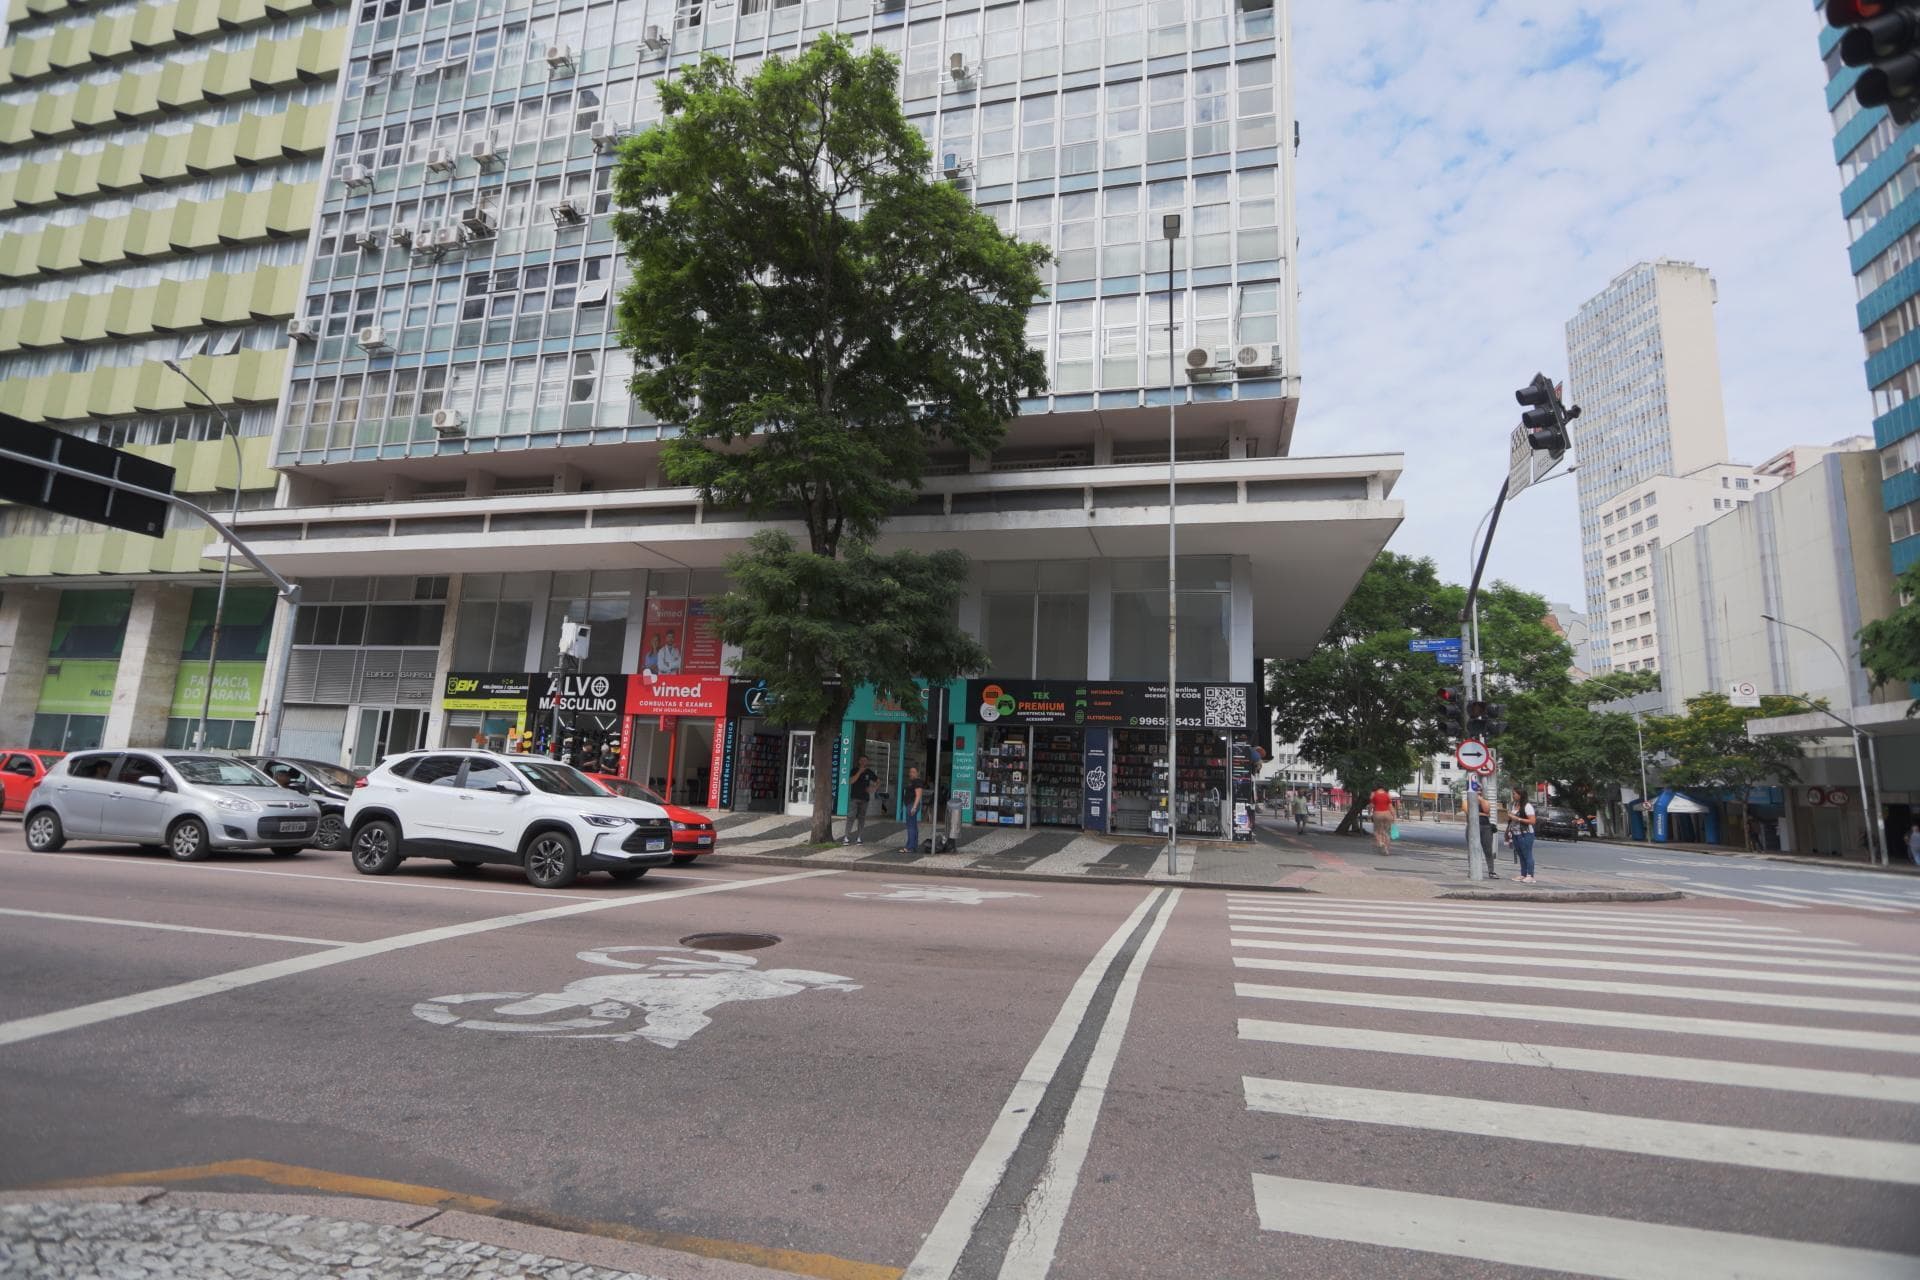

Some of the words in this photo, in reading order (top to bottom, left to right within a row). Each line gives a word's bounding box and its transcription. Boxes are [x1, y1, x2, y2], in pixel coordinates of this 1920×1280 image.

[184, 687, 200, 699] DO
[547, 676, 609, 697] ALVO
[652, 682, 701, 698] vimed
[539, 697, 617, 711] MASCULINO
[1018, 702, 1065, 711] PREMIUM
[841, 735, 850, 785] ÓTICA
